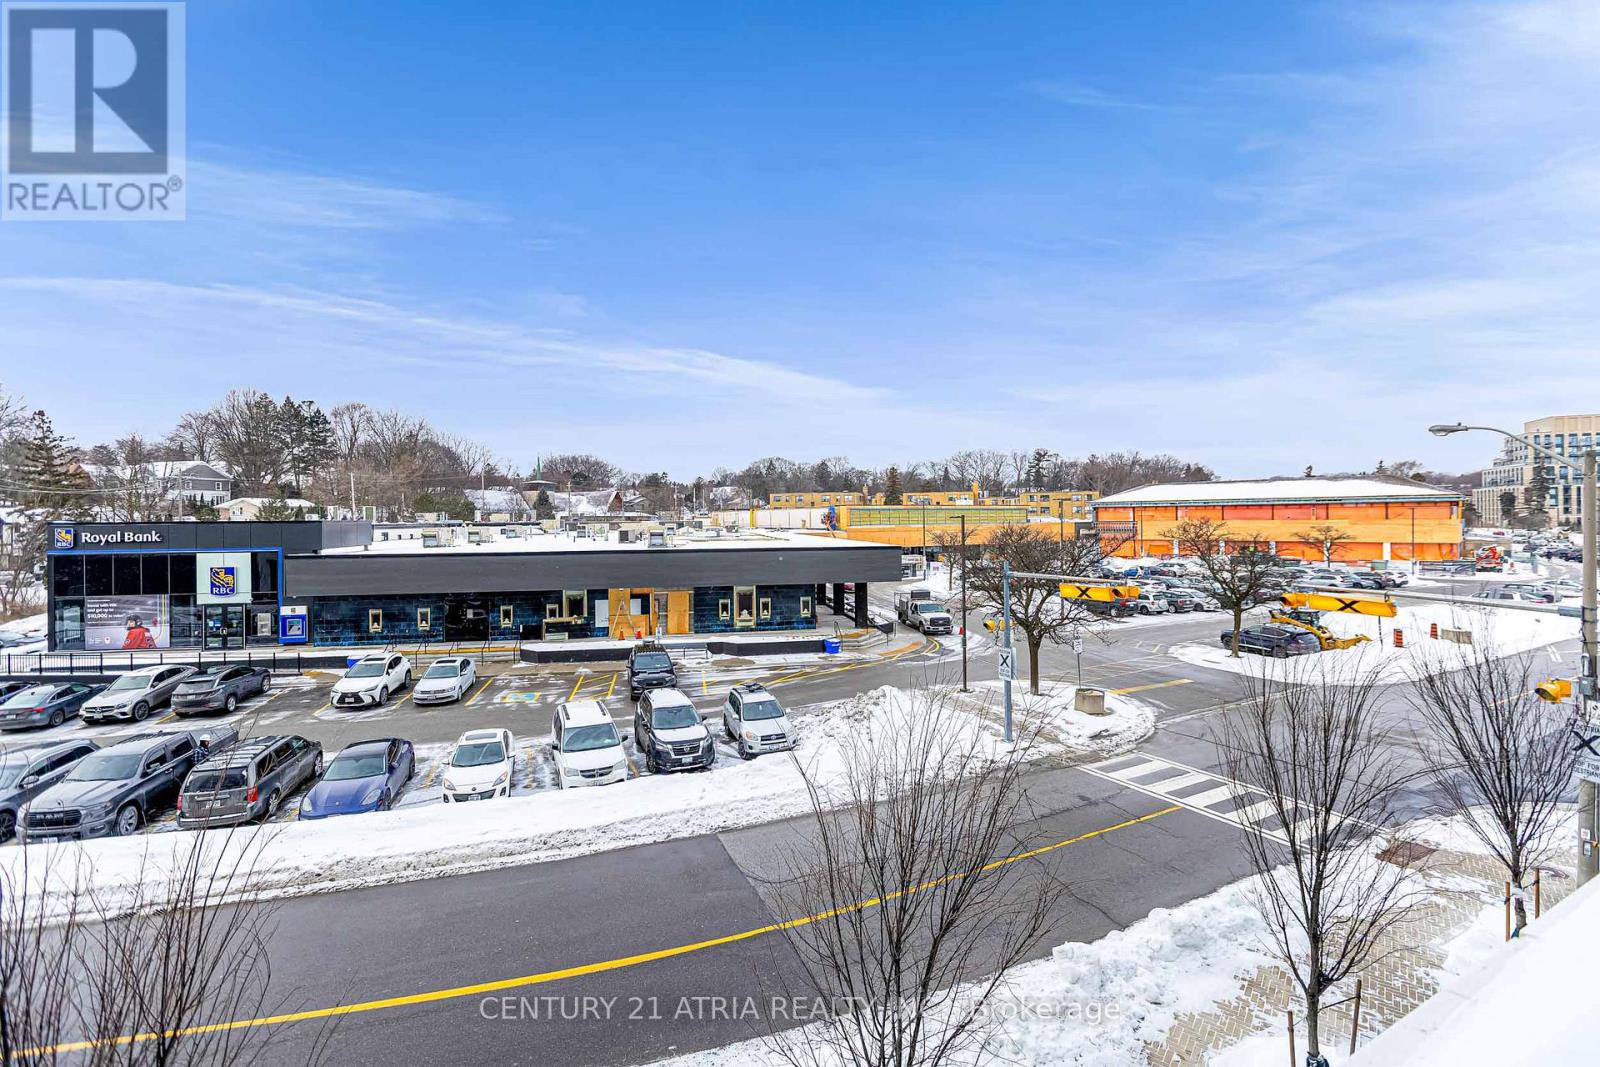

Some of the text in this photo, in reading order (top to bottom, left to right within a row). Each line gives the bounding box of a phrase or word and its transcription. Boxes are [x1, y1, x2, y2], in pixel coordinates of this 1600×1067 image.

[81, 530, 161, 546] Royal Bank
[213, 587, 234, 595] RBC
